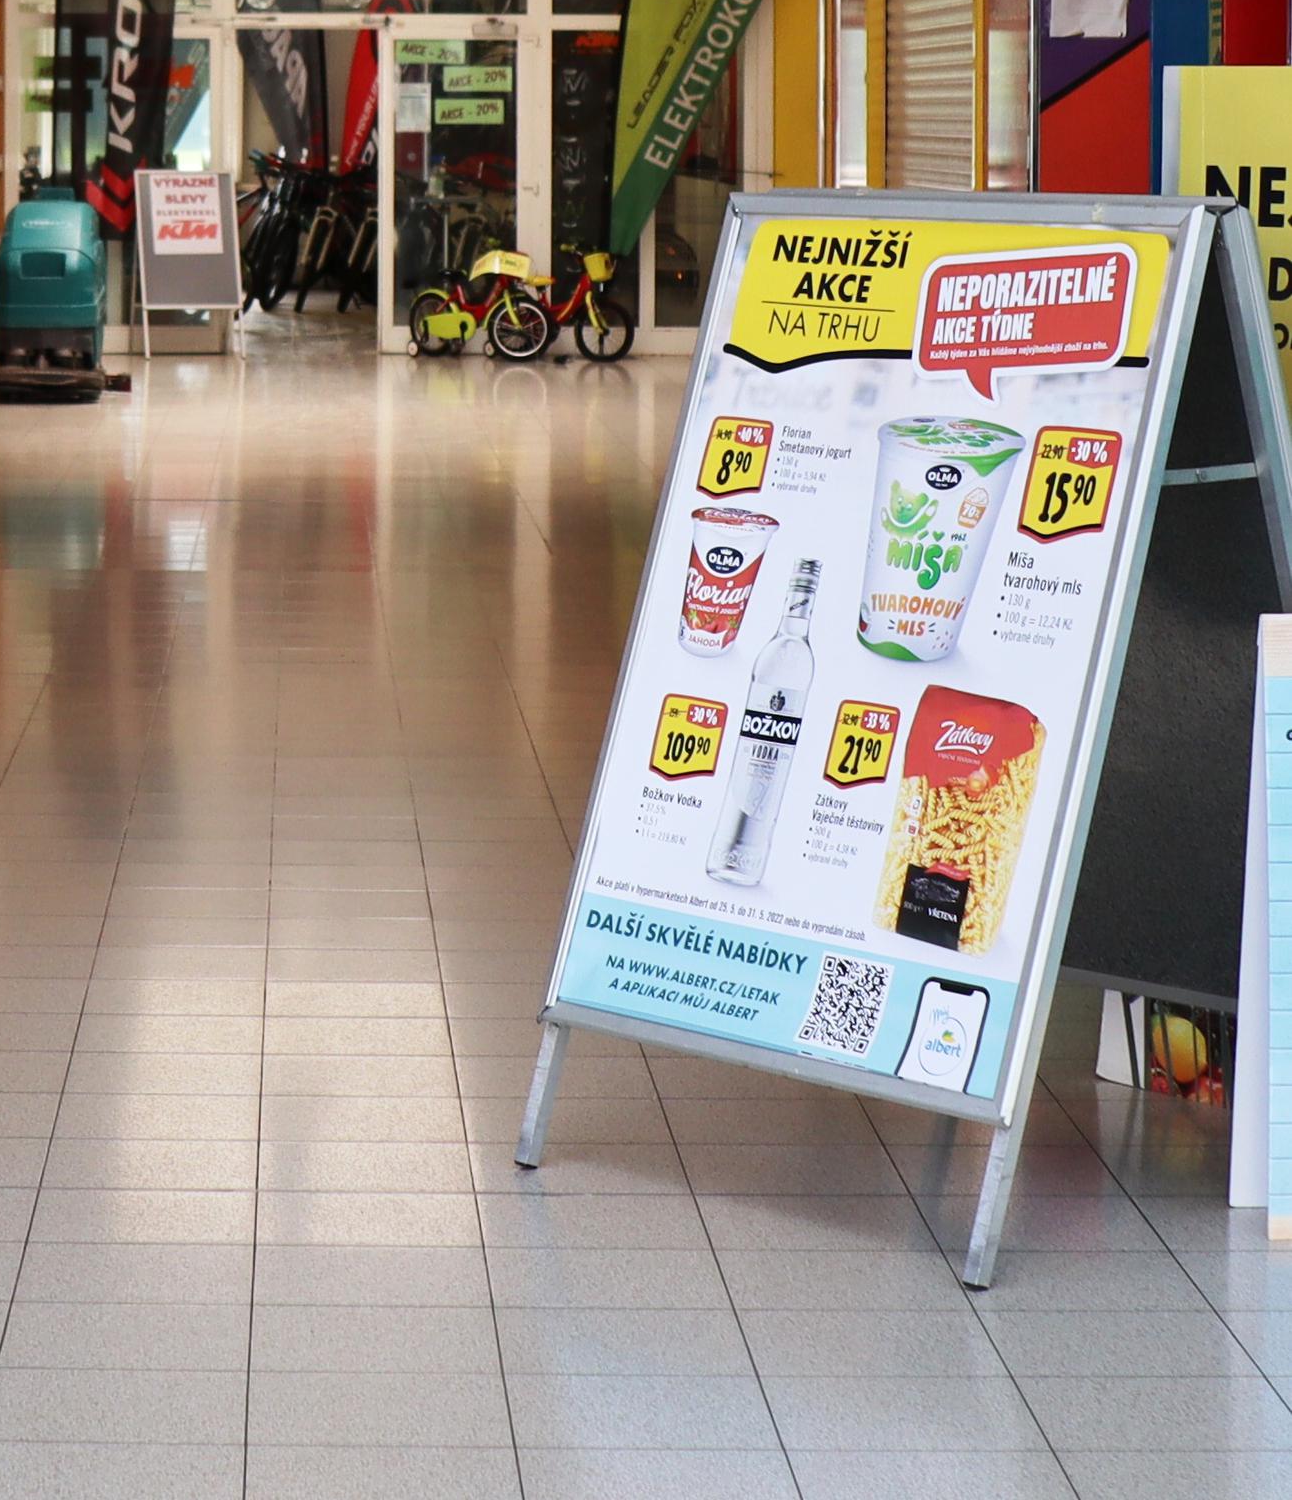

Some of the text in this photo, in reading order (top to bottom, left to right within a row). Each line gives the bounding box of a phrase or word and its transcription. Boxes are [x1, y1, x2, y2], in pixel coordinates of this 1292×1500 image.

[164, 194, 207, 205] SLEVY
[1205, 165, 1292, 228] NE
[157, 219, 218, 241] KTM
[773, 229, 913, 269] NEJNIŽŠÍ
[792, 271, 873, 304] AKCE
[936, 256, 1117, 313] NEPORAZITELNÉ
[768, 308, 881, 343] NA TRHU
[932, 308, 1035, 346] AKCE TÝDNE
[781, 426, 812, 440] Florian
[778, 440, 852, 460] Smetanový jogurt
[928, 471, 958, 484] OLMA
[708, 553, 741, 568] OLMA
[886, 530, 963, 590] MÍŠA
[1007, 551, 1035, 569] Míša
[687, 566, 754, 605] Florian
[1003, 572, 1083, 596] tvarohový mls
[871, 593, 966, 621] TVAROHOVÝ
[897, 619, 926, 636] MLS
[688, 634, 721, 647] JAHODA
[742, 714, 801, 741] BOŽKOV
[934, 720, 995, 755] Zátkovy
[751, 744, 780, 762] VODKA
[642, 786, 703, 809] Božkov Vodka
[815, 794, 848, 811] Zátkovy
[812, 808, 885, 835] Vaječné těstoviny
[635, 884, 688, 904] hypermarketech
[586, 909, 809, 976] DALŠÍ SKVĚLÉ NABÍDKY
[605, 954, 781, 1006] NA WWW.ALBERT.CZ/LETAK
[608, 977, 760, 1023] A APLIKACI MŮJ ALBERT
[925, 1038, 963, 1058] albert
